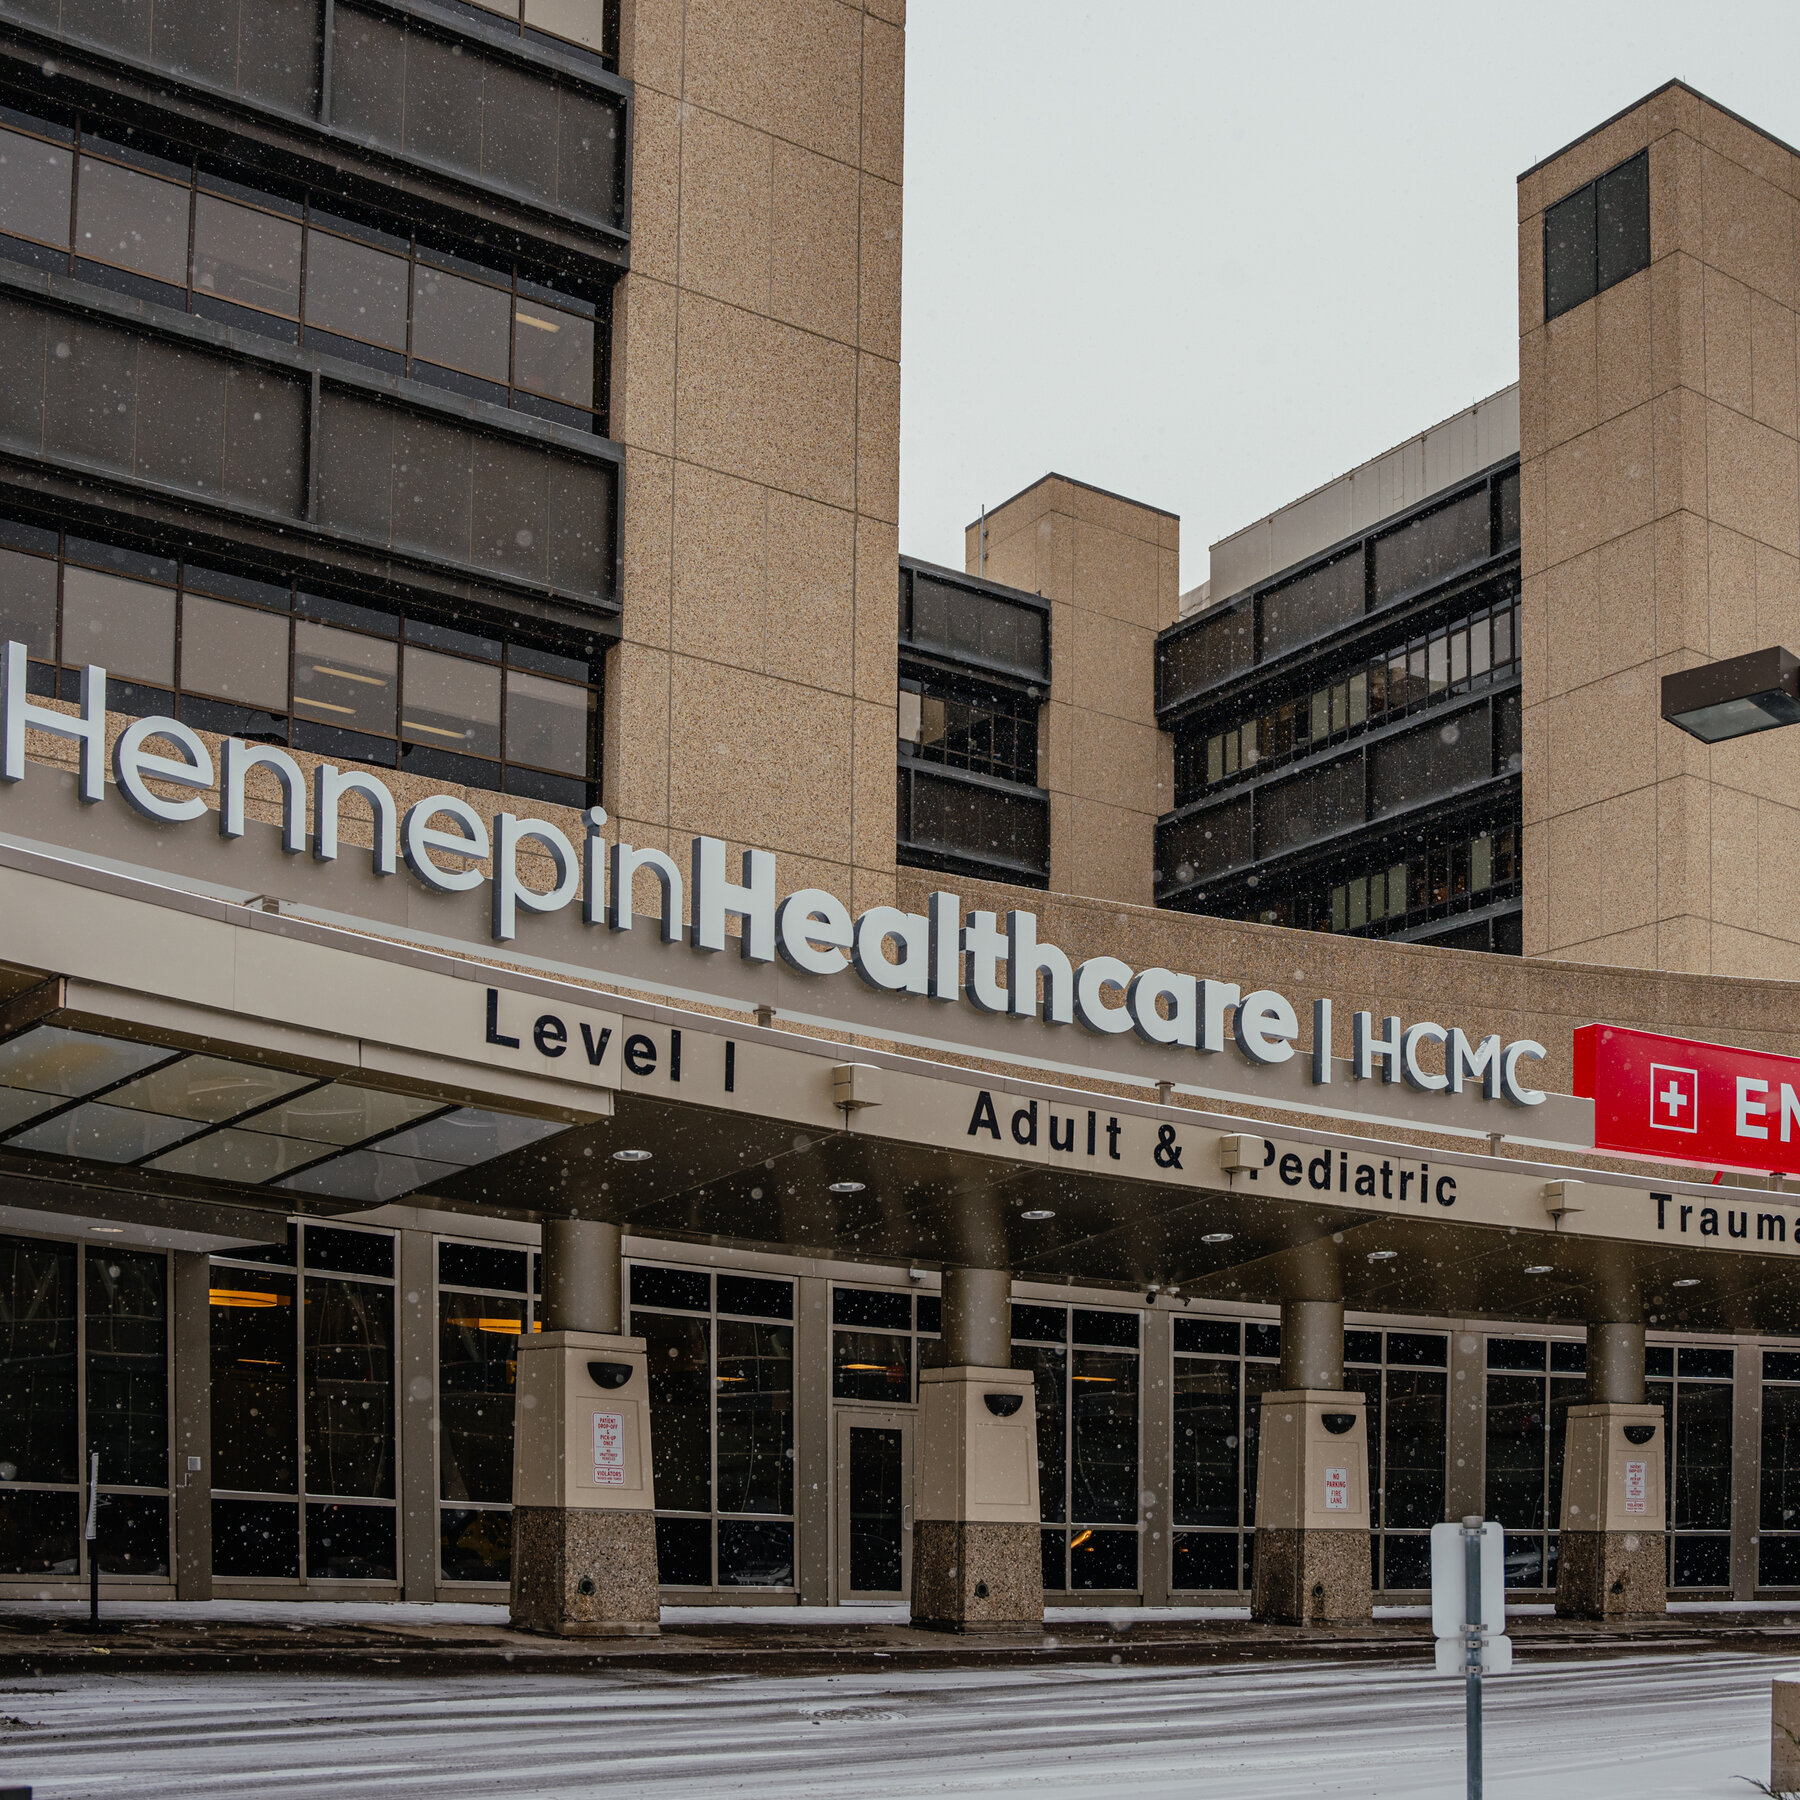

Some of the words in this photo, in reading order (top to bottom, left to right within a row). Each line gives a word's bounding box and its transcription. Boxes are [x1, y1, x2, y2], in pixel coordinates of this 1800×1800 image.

[485, 987, 682, 1082] Level
[967, 1090, 1122, 1160] Adult
[1153, 1124, 1184, 1170] &
[1650, 1192, 1800, 1244] Traum
[1353, 1011, 1547, 1107] HCMC
